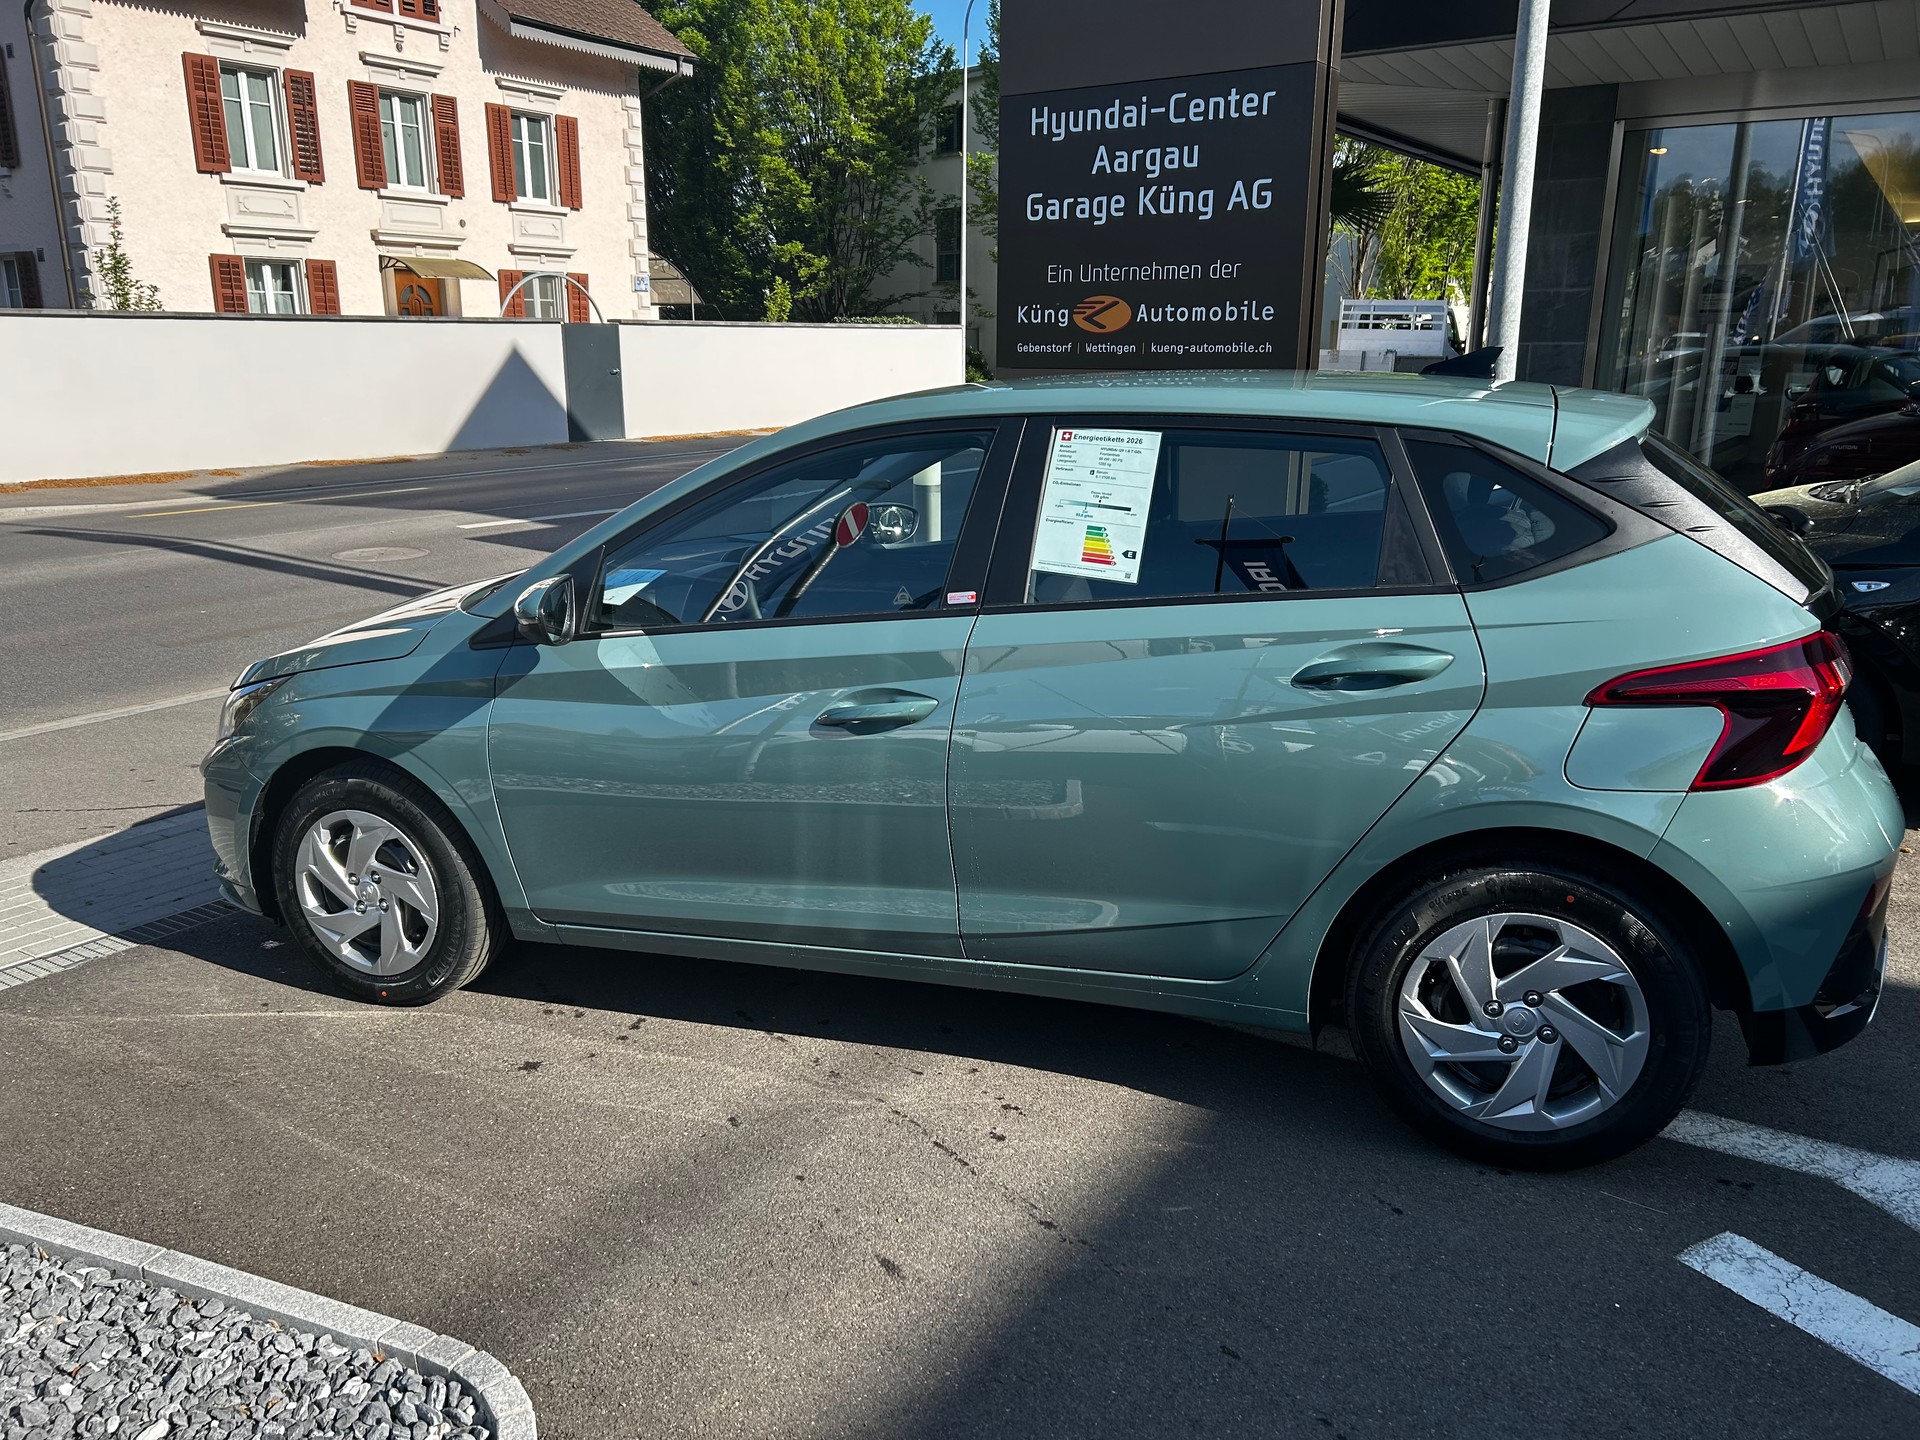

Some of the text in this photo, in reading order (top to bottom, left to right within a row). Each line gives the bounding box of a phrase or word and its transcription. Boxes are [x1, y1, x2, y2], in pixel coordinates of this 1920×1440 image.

[1031, 88, 1277, 142] Hyundai-Center
[1091, 145, 1199, 178] Aargau
[1026, 178, 1273, 226] Garage Küng AG
[1047, 259, 1242, 283] Ein Unternehmen der
[1017, 300, 1275, 327] Küng Automobile
[1017, 342, 1273, 355] Gebenstorf Wettingen kueng-automobile.ch
[1073, 433, 1143, 445] Energieetikette 2026
